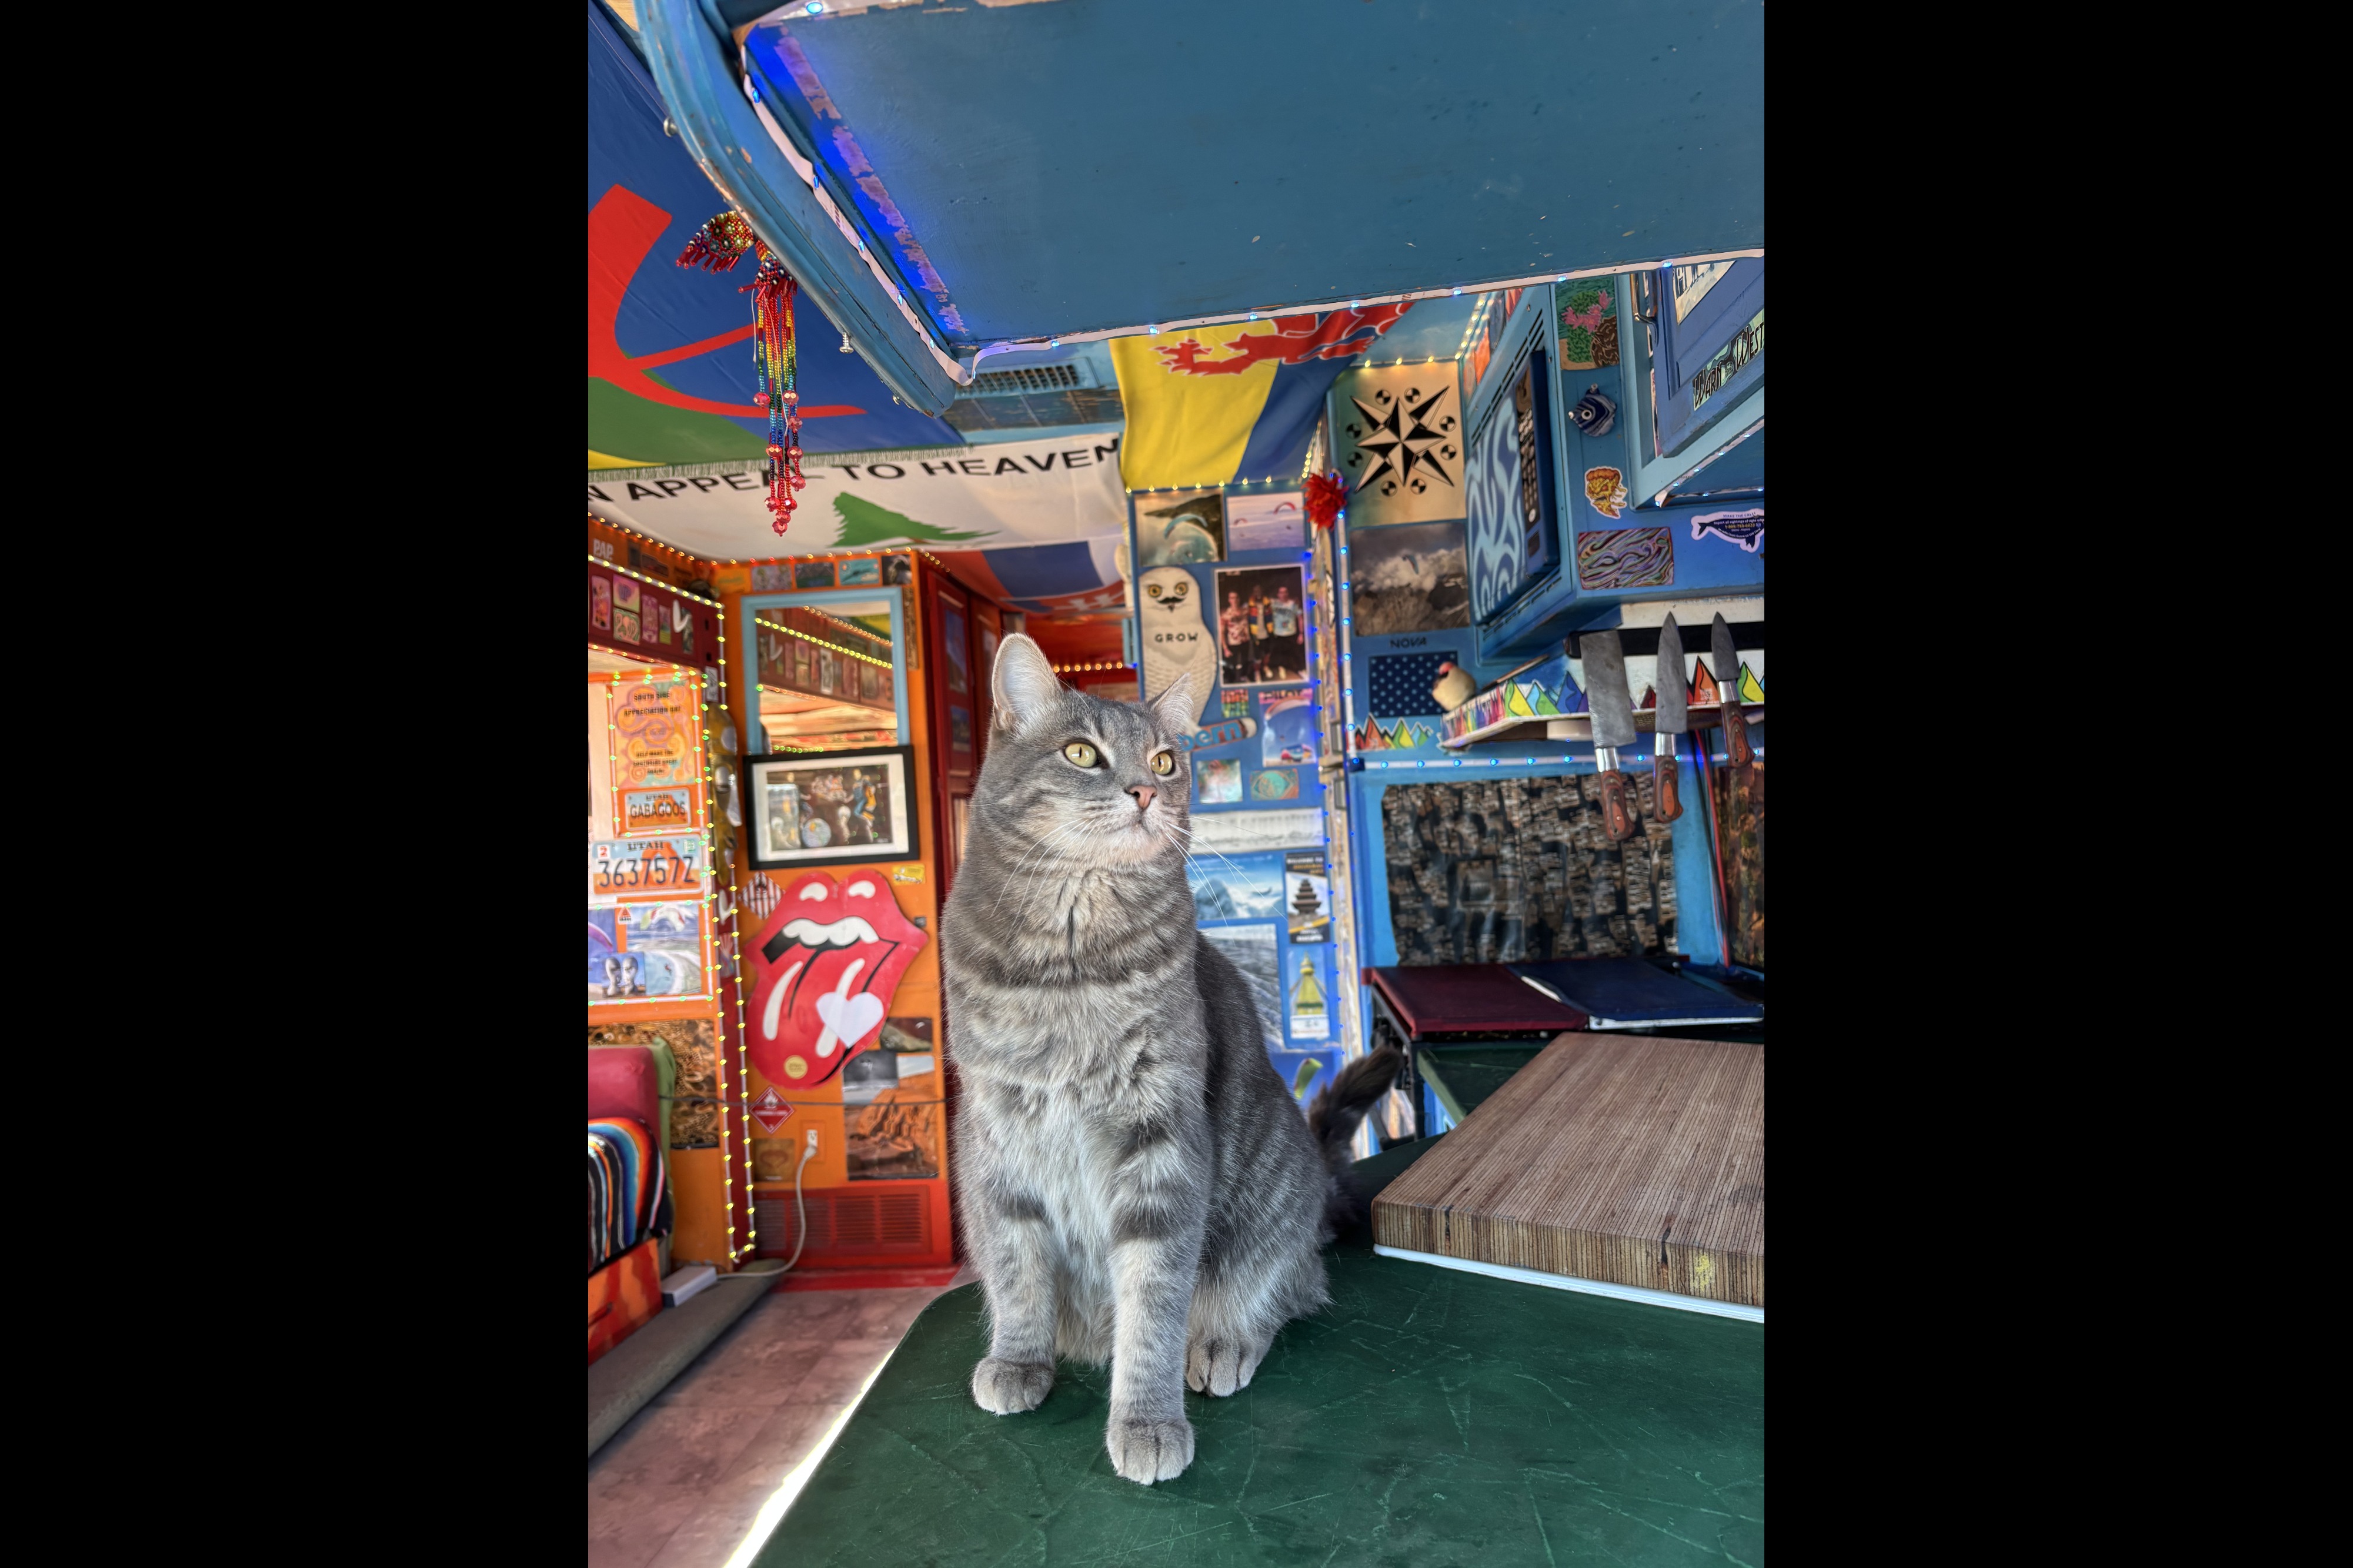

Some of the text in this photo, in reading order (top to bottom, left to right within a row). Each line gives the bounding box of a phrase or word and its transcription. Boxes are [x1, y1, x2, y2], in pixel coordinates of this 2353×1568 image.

[1694, 322, 1764, 408] WARN WEST
[832, 463, 906, 480] TO
[919, 438, 1119, 476] HEAVEN
[1154, 632, 1200, 643] GROW
[1390, 637, 1427, 648] NOVA
[633, 693, 655, 701] SOUTH
[600, 846, 608, 857] 2
[627, 842, 664, 852] UTAH
